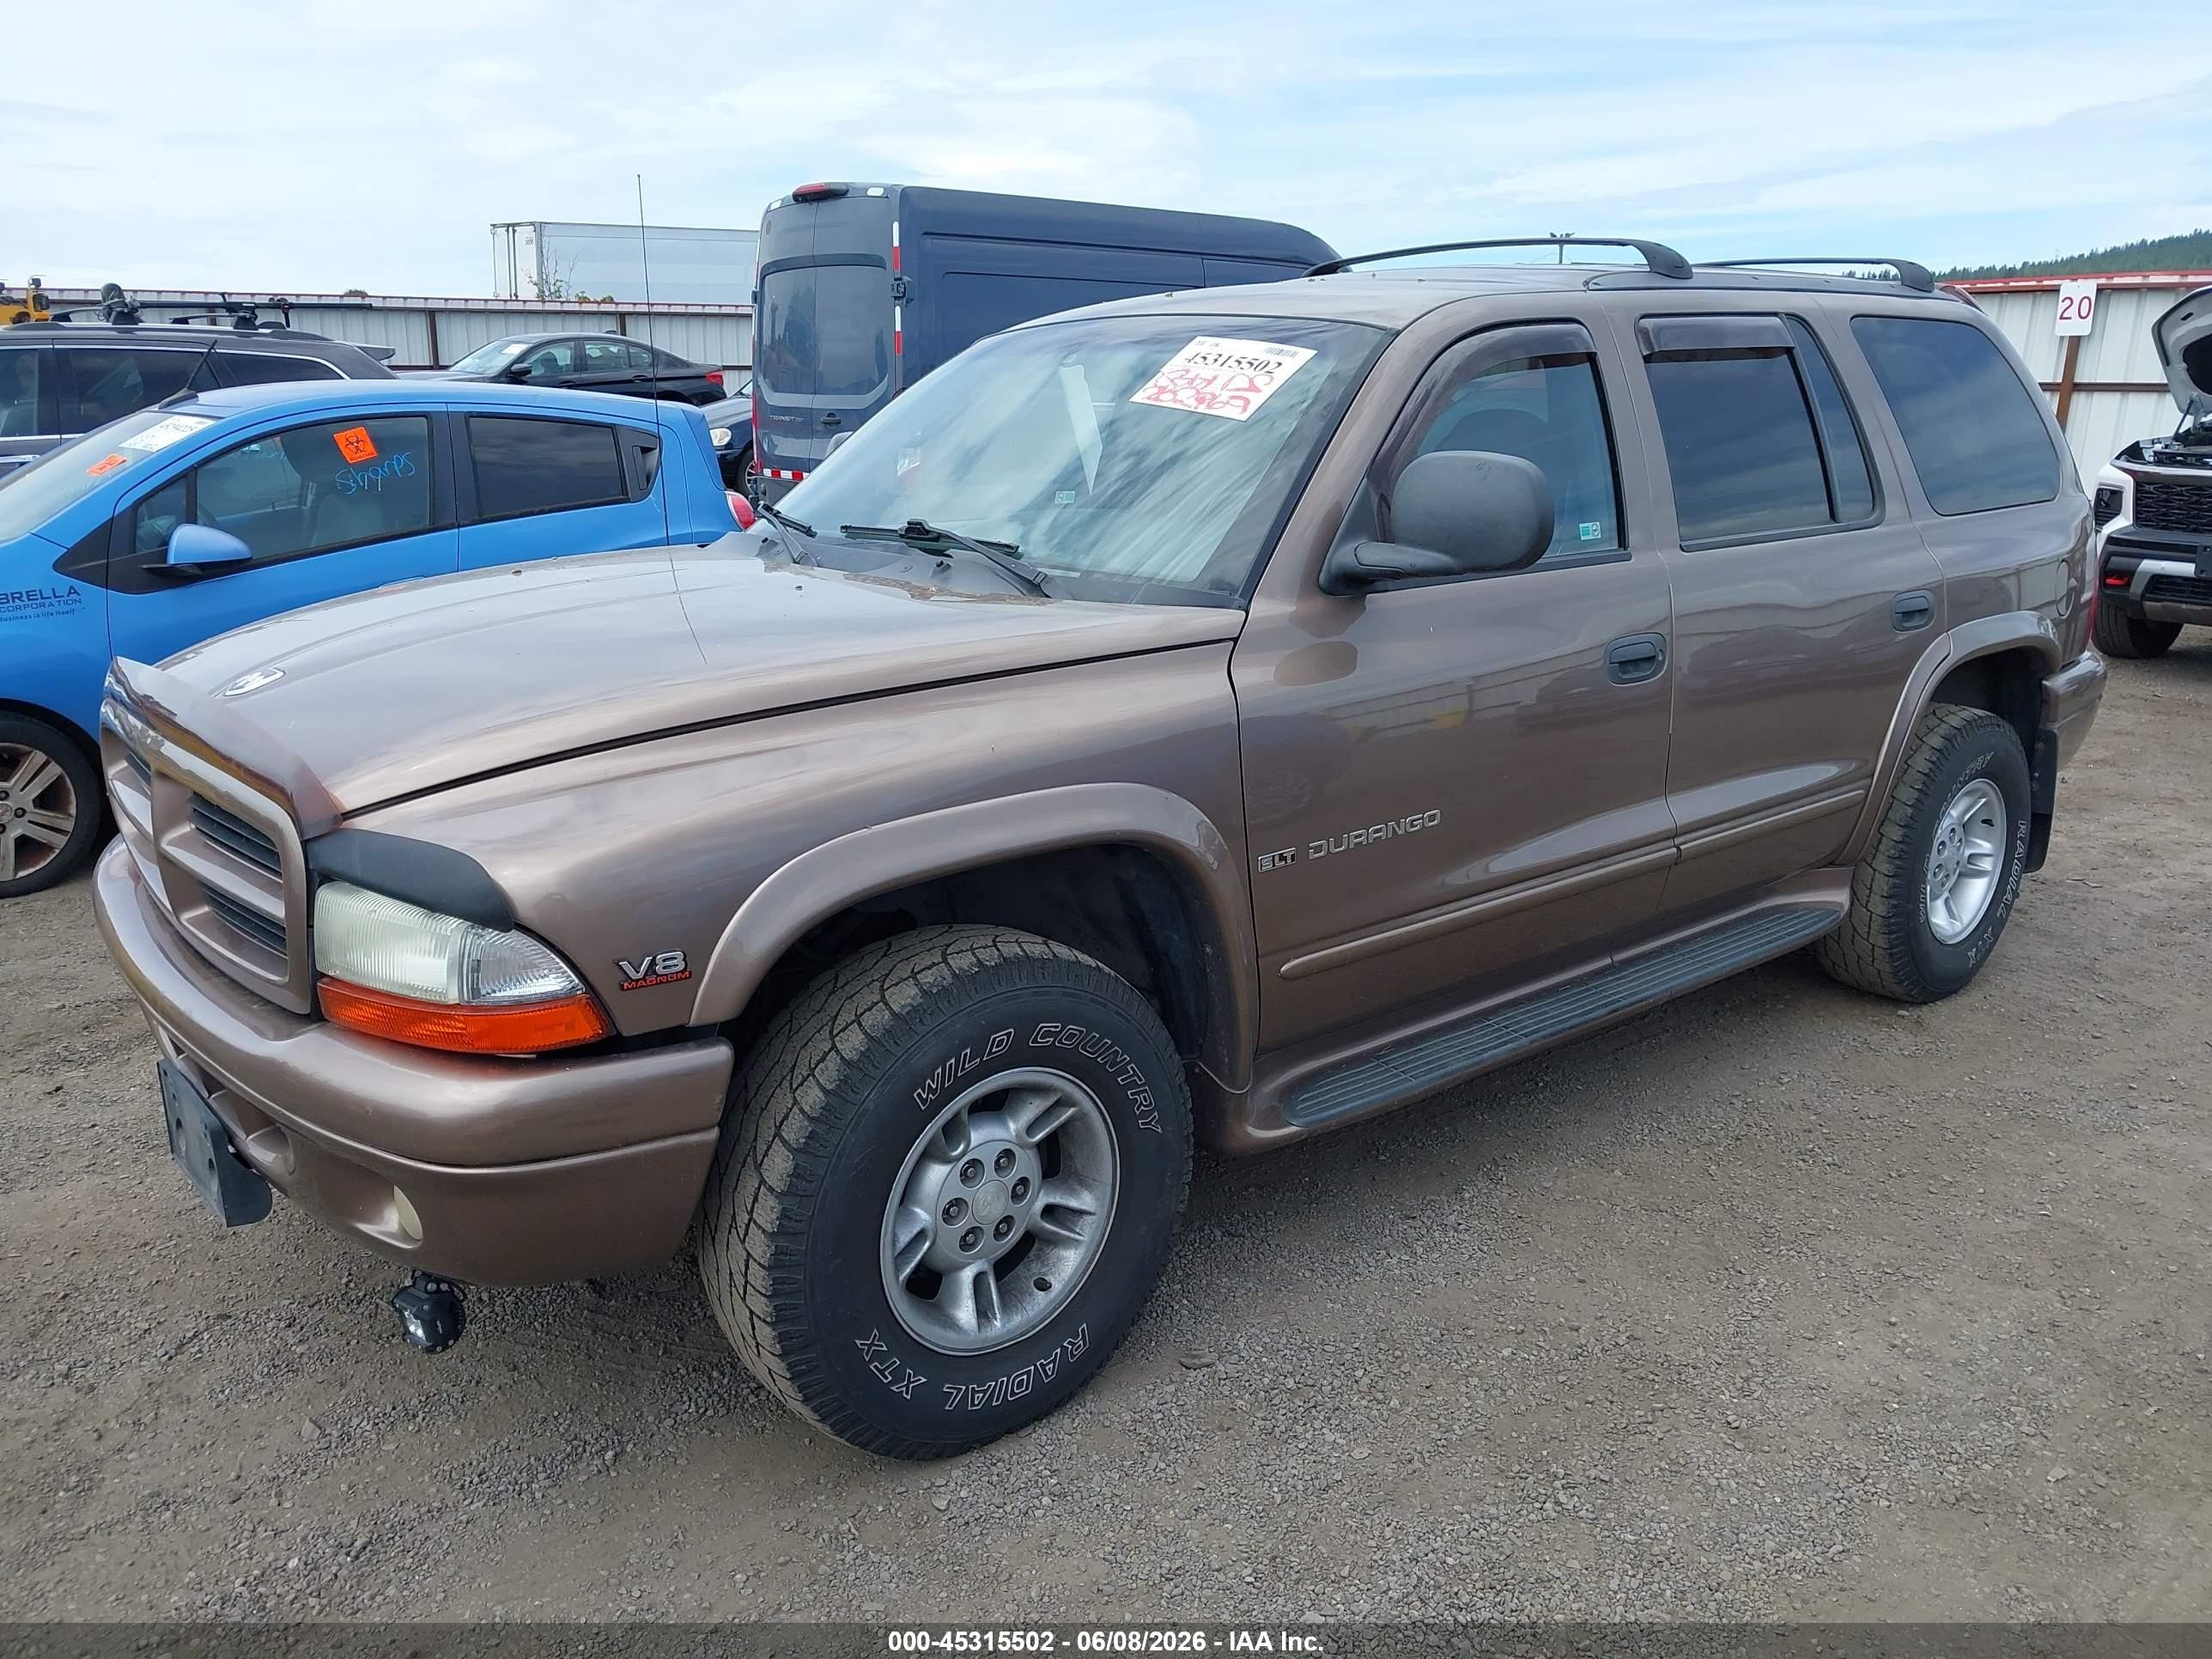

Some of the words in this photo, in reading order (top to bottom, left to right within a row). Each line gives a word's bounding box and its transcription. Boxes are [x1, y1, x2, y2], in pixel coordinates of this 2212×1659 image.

[2058, 296, 2093, 320] 20
[1185, 351, 1283, 374] 45315502
[335, 452, 416, 495] Sharps
[0, 599, 82, 613] CORPORATION
[41, 610, 55, 619] life
[1261, 849, 1296, 871] SLT
[1308, 809, 1442, 860] DURANGO
[1996, 819, 2027, 921] RADIAL
[618, 951, 686, 980] V8
[623, 970, 690, 990] MAGNUM
[912, 1028, 1016, 1112] WILD
[1030, 1022, 1163, 1134] COUNTRY
[855, 1328, 927, 1401] XTX
[943, 1322, 1089, 1412] RADIAL
